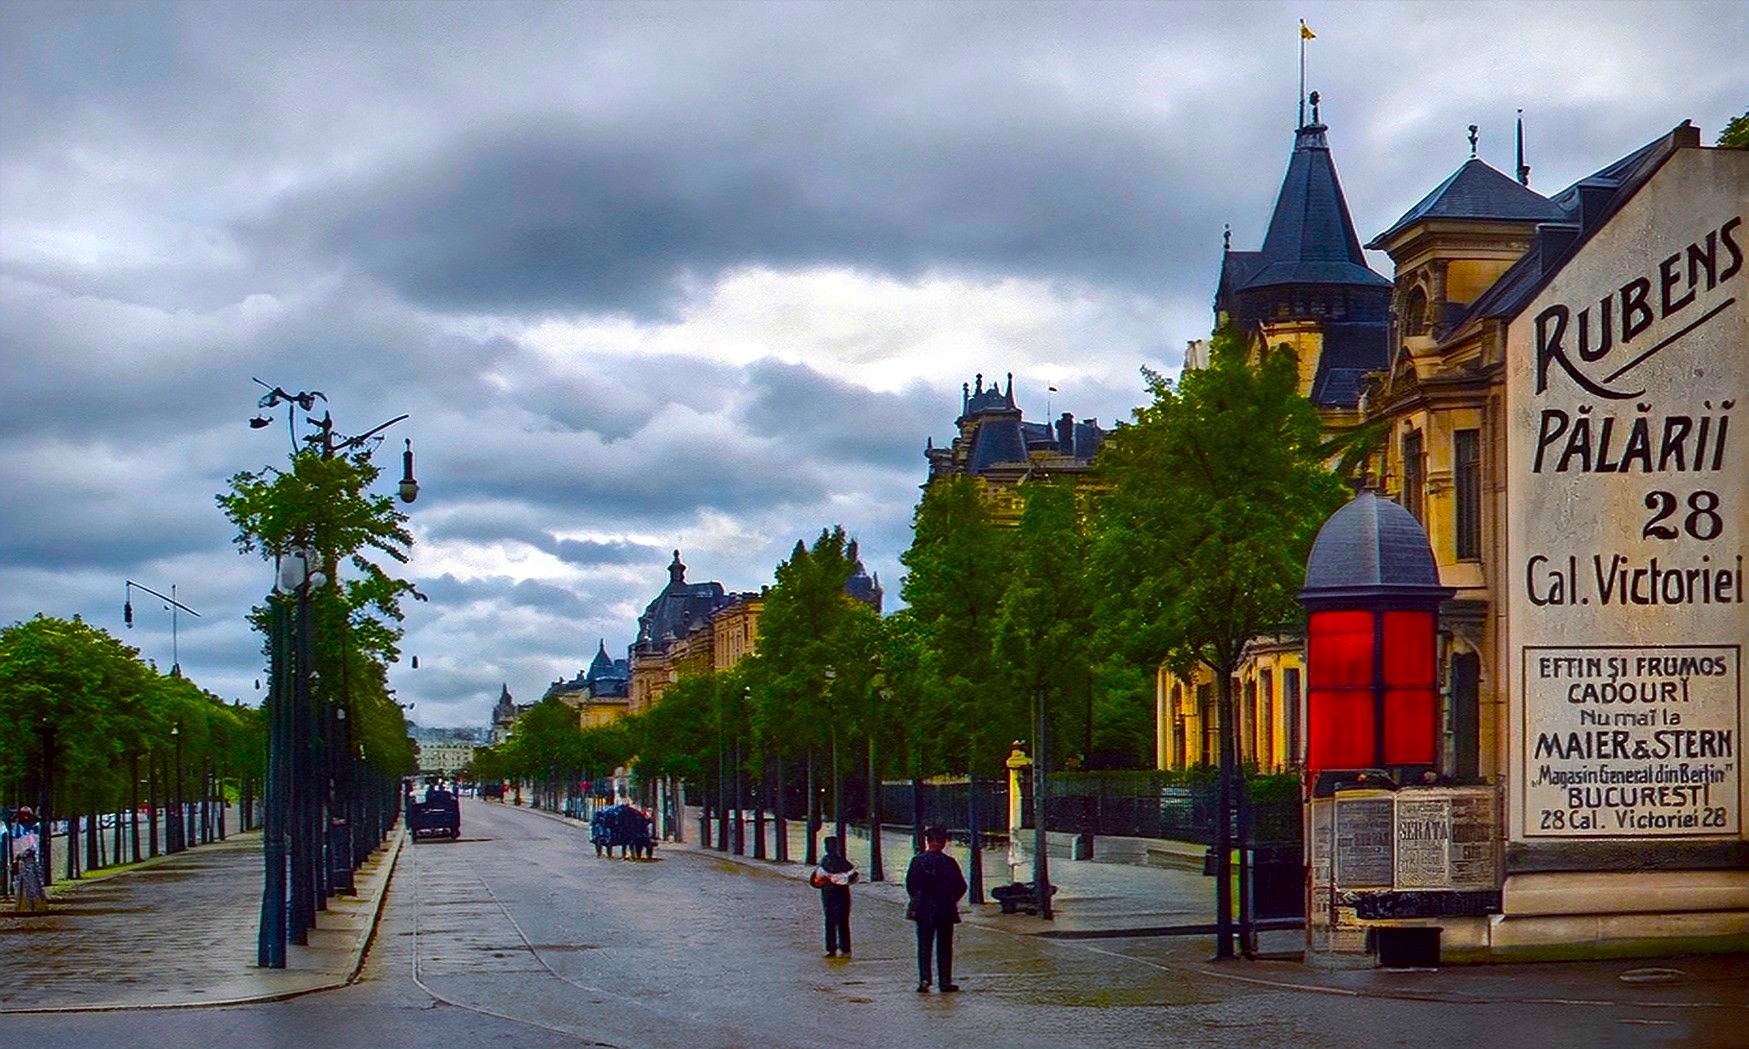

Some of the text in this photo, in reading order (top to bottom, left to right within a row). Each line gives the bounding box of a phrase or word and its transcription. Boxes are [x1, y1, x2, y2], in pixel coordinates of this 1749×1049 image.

[1535, 216, 1743, 399] RUBENS
[1643, 490, 1723, 541] 28
[1527, 553, 1744, 606] Cal. Victoriei
[1540, 657, 1602, 678] EFTIN
[1636, 656, 1727, 677] FRUMOS
[1663, 709, 1681, 726] la
[1600, 764, 1652, 784] General
[1655, 764, 1678, 784] din
[1540, 807, 1727, 830] 28 Cal. Victoriei 28
